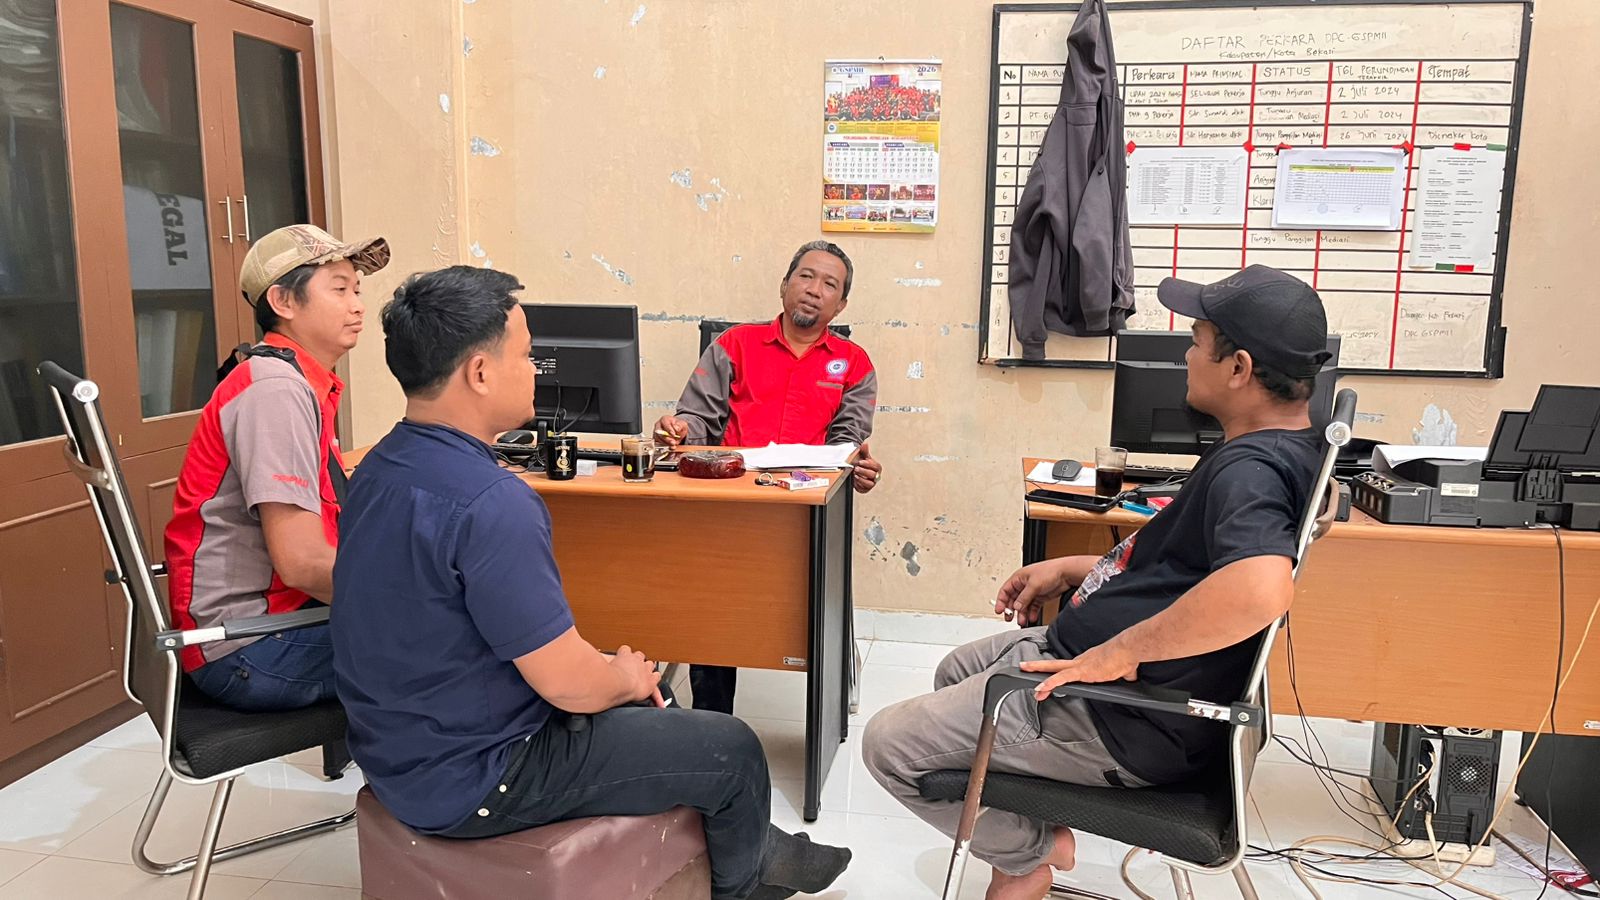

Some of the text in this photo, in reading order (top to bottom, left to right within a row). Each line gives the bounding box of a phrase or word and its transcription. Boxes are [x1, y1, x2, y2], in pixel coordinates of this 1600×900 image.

[1182, 35, 1246, 50] DAFTAR
[1263, 67, 1311, 78] STATUS
[1427, 64, 1471, 81] Tempat
[1338, 86, 1346, 98] 2
[1374, 86, 1400, 96] 2024
[1378, 110, 1402, 120] 2024
[1002, 191, 1008, 200] 6
